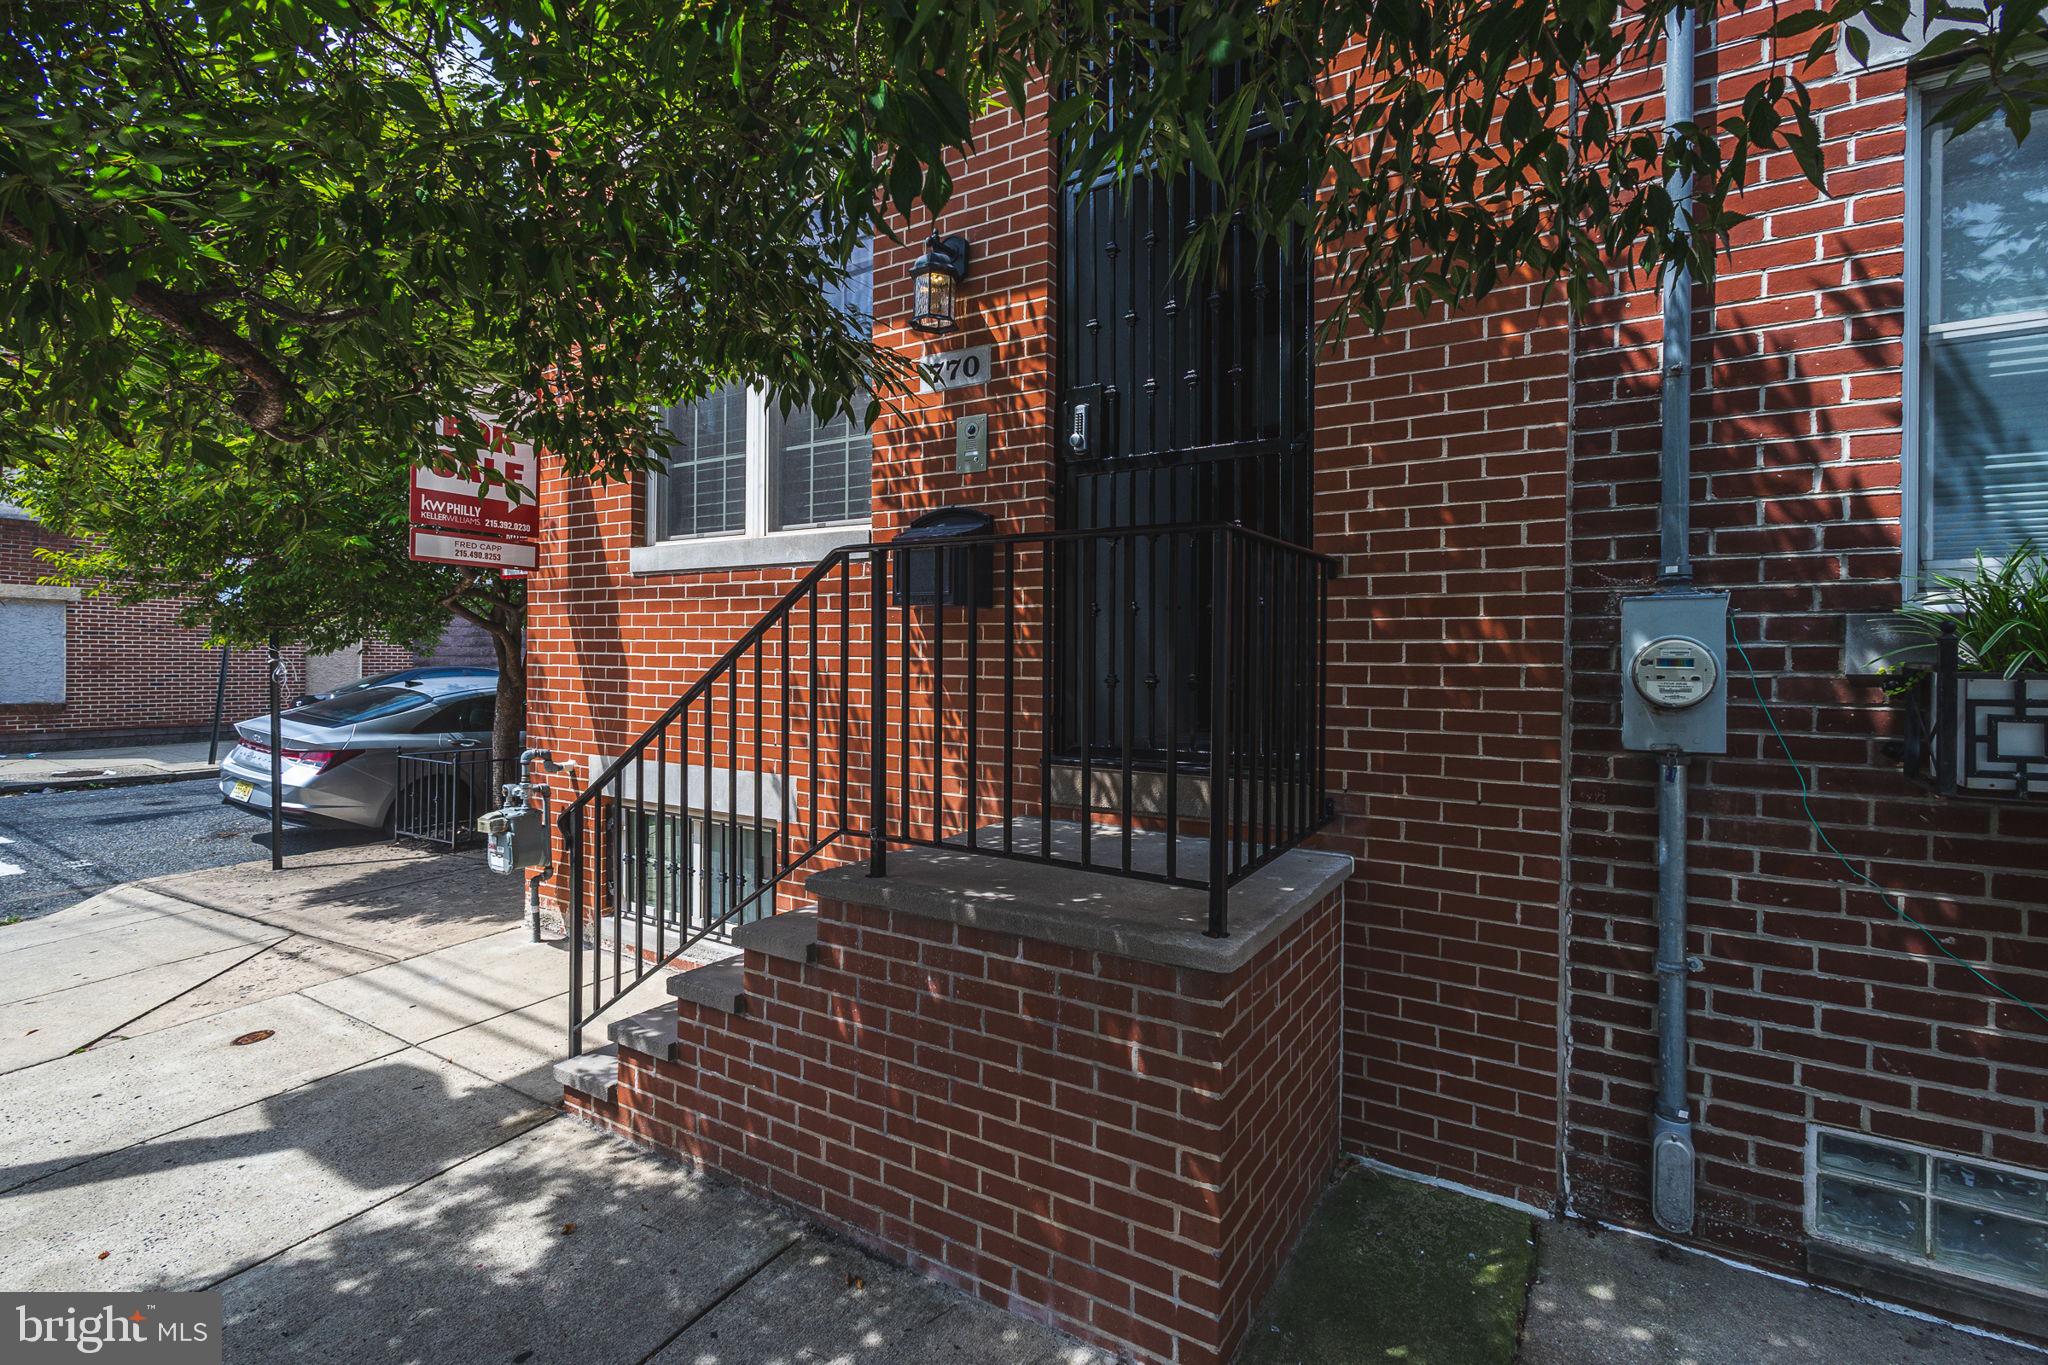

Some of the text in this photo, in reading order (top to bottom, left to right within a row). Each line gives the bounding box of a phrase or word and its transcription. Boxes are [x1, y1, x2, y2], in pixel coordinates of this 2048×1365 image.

[446, 502, 482, 518] PHILLY
[485, 519, 531, 532] 215.392.0230
[454, 540, 502, 552] FRED CAPP
[454, 549, 502, 561] 215.490.8253
